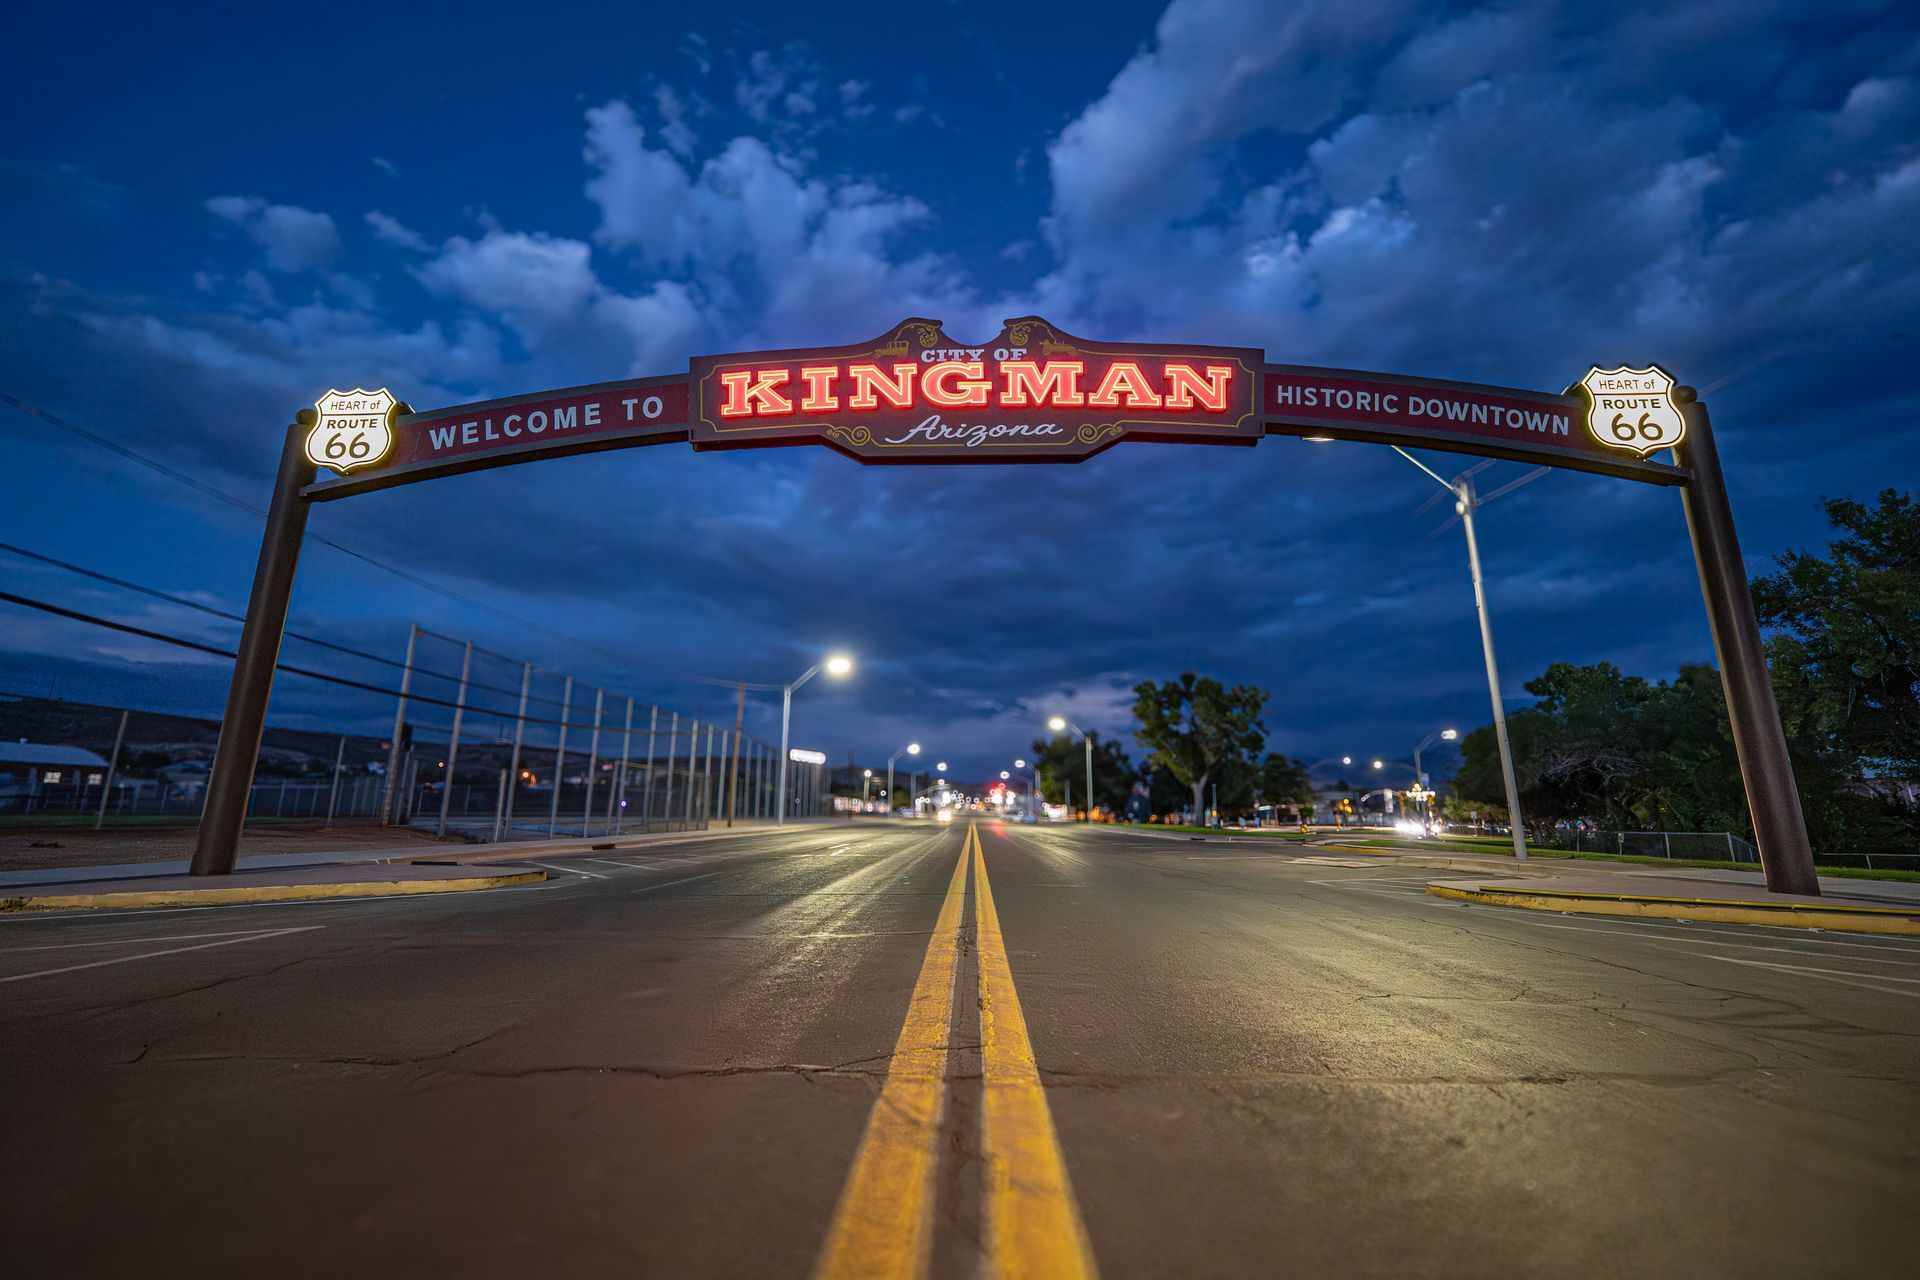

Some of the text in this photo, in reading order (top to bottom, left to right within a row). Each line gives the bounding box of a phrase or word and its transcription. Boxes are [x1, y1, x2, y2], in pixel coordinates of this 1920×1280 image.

[921, 348, 1027, 362] CITY OF
[721, 361, 1231, 415] KINGMAN
[1599, 379, 1654, 390] HEART of
[330, 400, 381, 411] HEART of
[1278, 385, 1569, 436] HISTORIC DOWNTOWN
[1602, 399, 1661, 409] ROUTE
[327, 419, 378, 429] ROUTE
[429, 396, 663, 450] WELCOME TO
[885, 415, 1063, 447] Arizona
[1612, 413, 1663, 441] 66
[325, 432, 370, 459] 66
